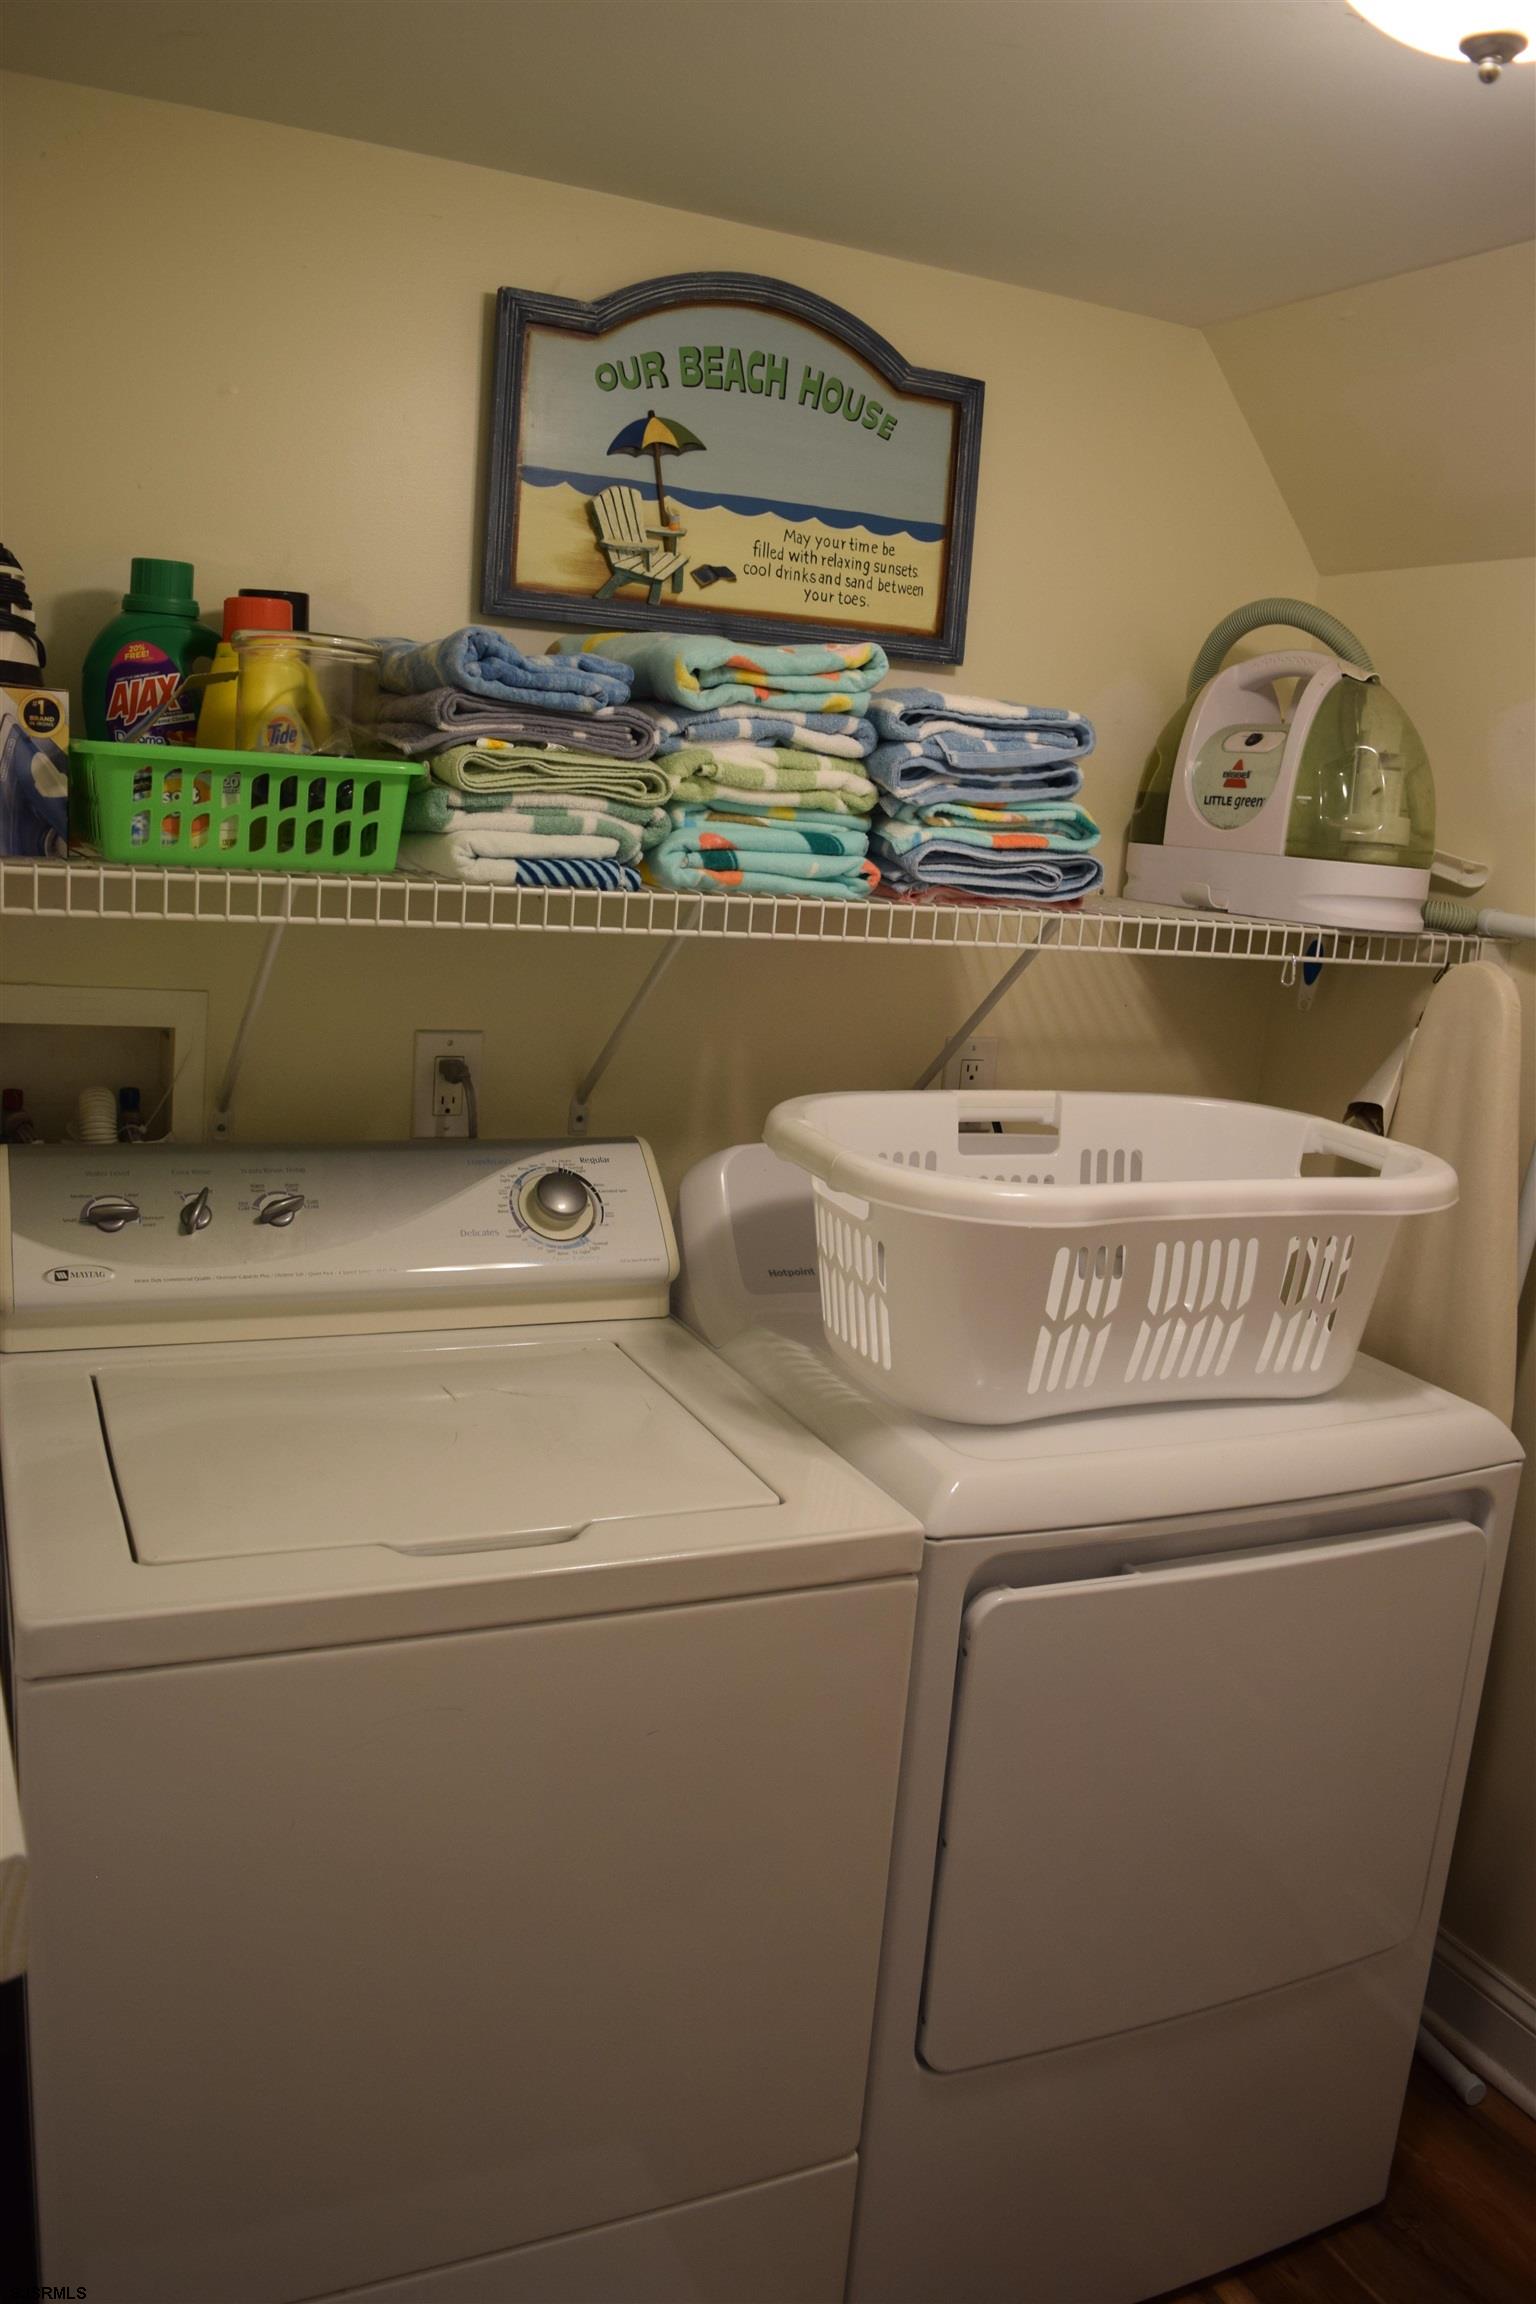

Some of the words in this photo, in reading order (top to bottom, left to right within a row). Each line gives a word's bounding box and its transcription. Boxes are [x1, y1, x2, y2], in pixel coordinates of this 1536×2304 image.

[594, 350, 669, 393] OUR
[678, 345, 789, 400] BEACH
[798, 364, 898, 441] HOUSE
[783, 529, 811, 548] May
[815, 536, 845, 551] your
[849, 537, 878, 554] time
[882, 541, 895, 557] be
[753, 539, 784, 561] filled
[788, 545, 818, 566] with
[821, 553, 870, 576] relaxing
[743, 562, 771, 577] cool
[775, 564, 816, 584] drinks
[818, 571, 841, 586] and
[845, 574, 873, 591] sand
[877, 577, 924, 597] between
[803, 588, 834, 604] your
[838, 590, 869, 607] toes.
[106, 672, 180, 726] AJAX
[267, 723, 297, 746] Tide
[1203, 796, 1232, 806] LITTLE
[1234, 796, 1264, 810] green
[580, 1156, 610, 1164] Regular
[70, 1271, 105, 1279] MAYTAG
[768, 1267, 816, 1277] Hotpoint
